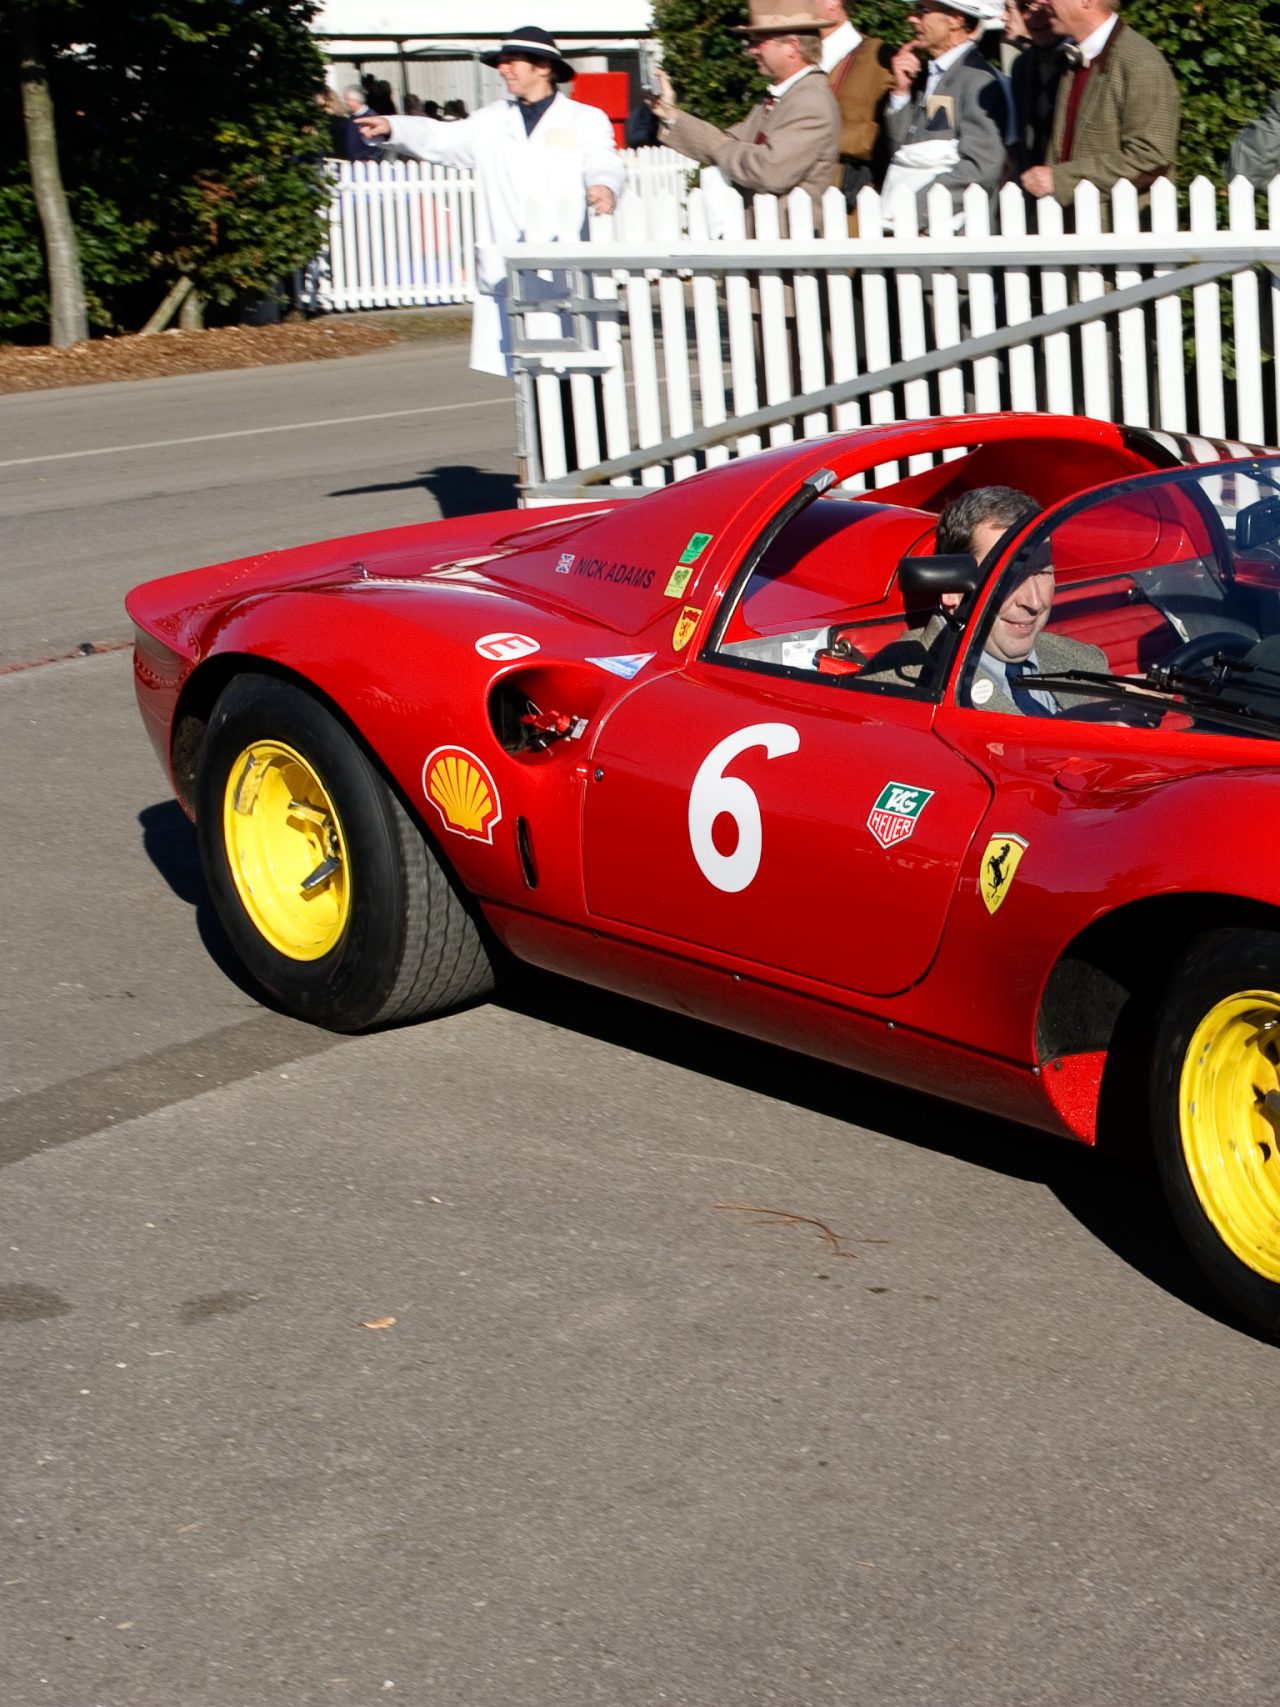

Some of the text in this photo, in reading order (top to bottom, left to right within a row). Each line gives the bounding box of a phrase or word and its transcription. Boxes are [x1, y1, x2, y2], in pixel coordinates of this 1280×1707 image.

[575, 557, 608, 581] NICK
[605, 563, 656, 589] ADAMS
[479, 635, 537, 659] E
[688, 722, 800, 893] 6
[884, 787, 919, 814] TAG
[871, 811, 912, 843] HEUER
